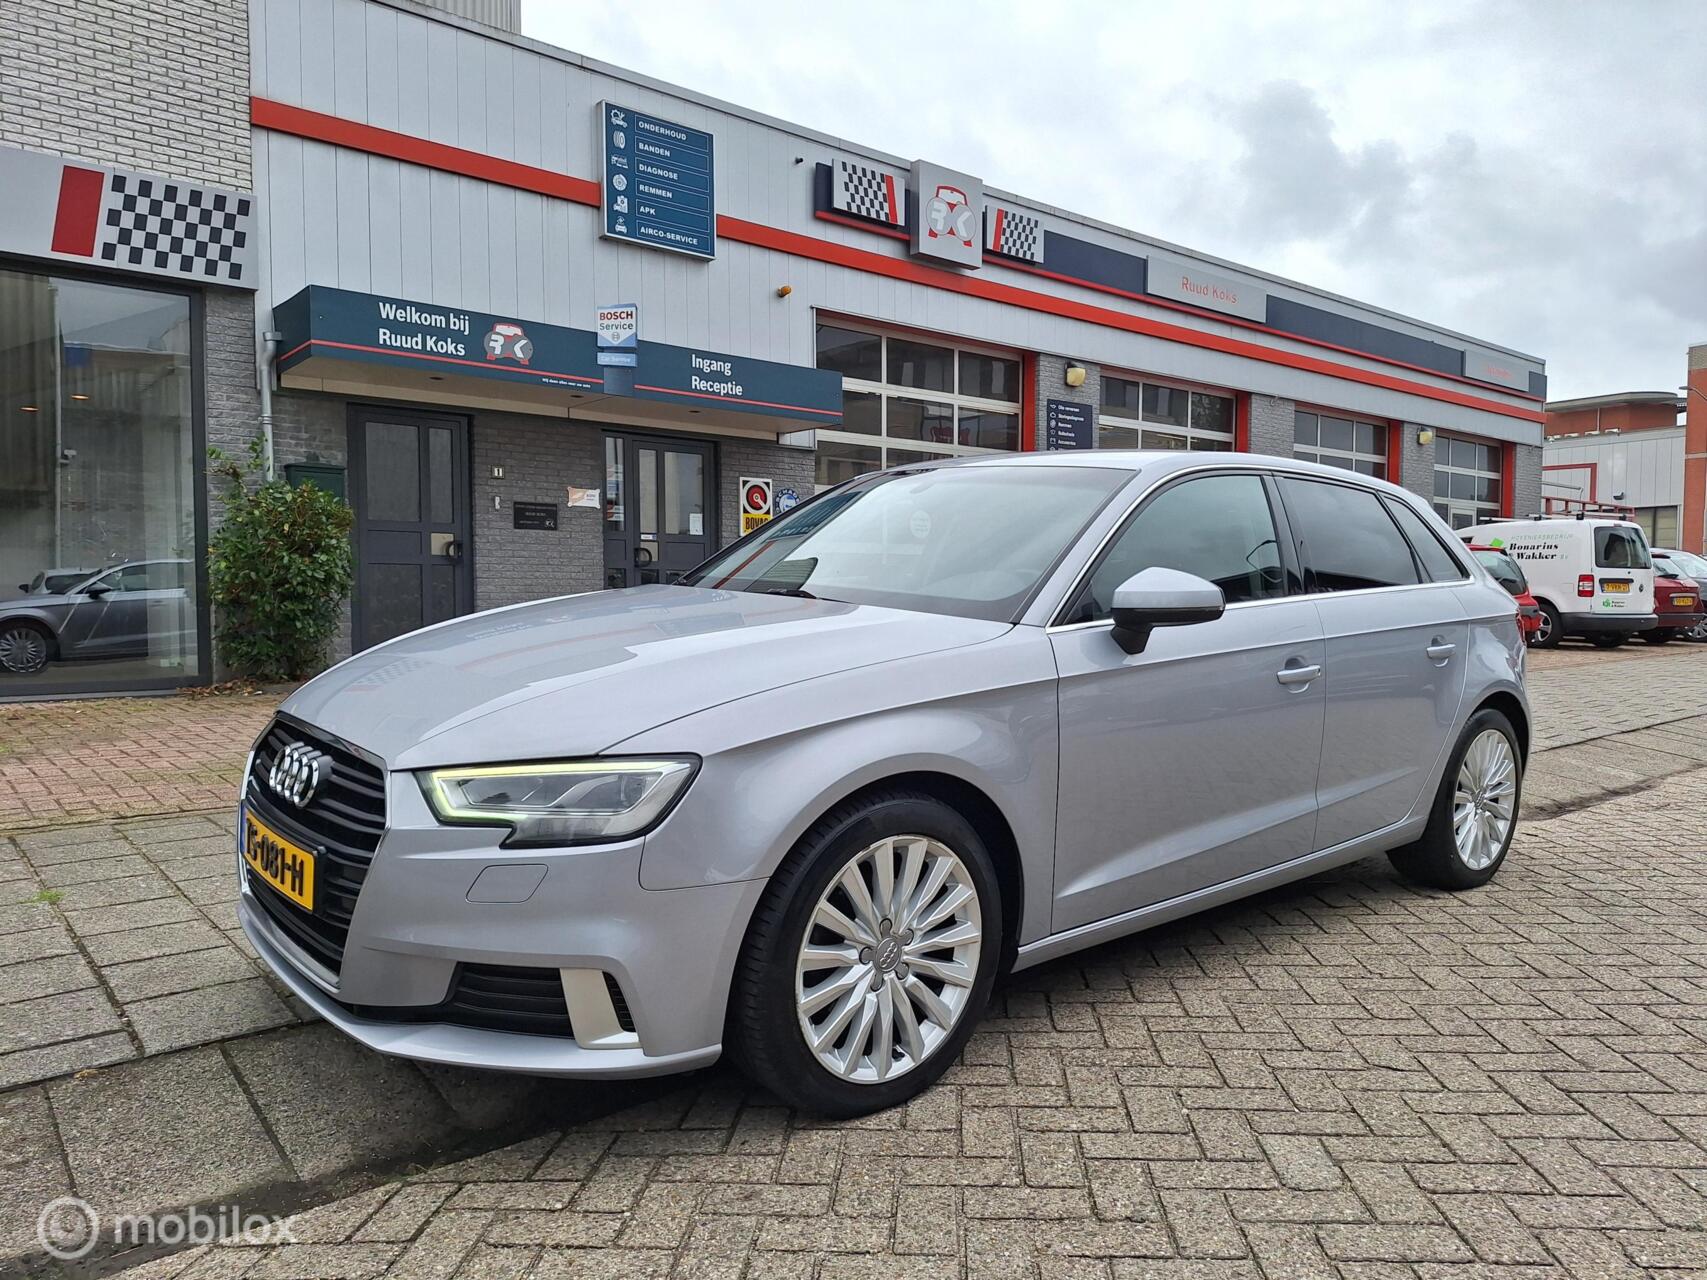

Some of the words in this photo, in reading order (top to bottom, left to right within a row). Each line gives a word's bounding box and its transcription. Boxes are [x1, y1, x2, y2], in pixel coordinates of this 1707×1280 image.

[638, 120, 687, 141] ONDERHOUD
[638, 142, 671, 158] BANDEN
[639, 163, 678, 180] DIAGNOSE
[639, 184, 673, 199] REMMEN
[639, 205, 656, 215] APK
[640, 226, 698, 245] AIRCO-SERVICE
[1181, 275, 1209, 296] Ruud
[1212, 284, 1238, 304] Koks
[379, 302, 446, 328] Welkom
[449, 313, 469, 335] bij
[599, 310, 634, 320] BOSCH
[599, 322, 634, 331] Service
[378, 328, 422, 350] Ruud
[426, 335, 466, 356] Koks
[692, 354, 732, 376] Ingang
[691, 375, 743, 396] Receptie
[745, 516, 769, 530] BOVA
[1509, 541, 1559, 551] Bonarius
[1516, 551, 1557, 560] Wakker
